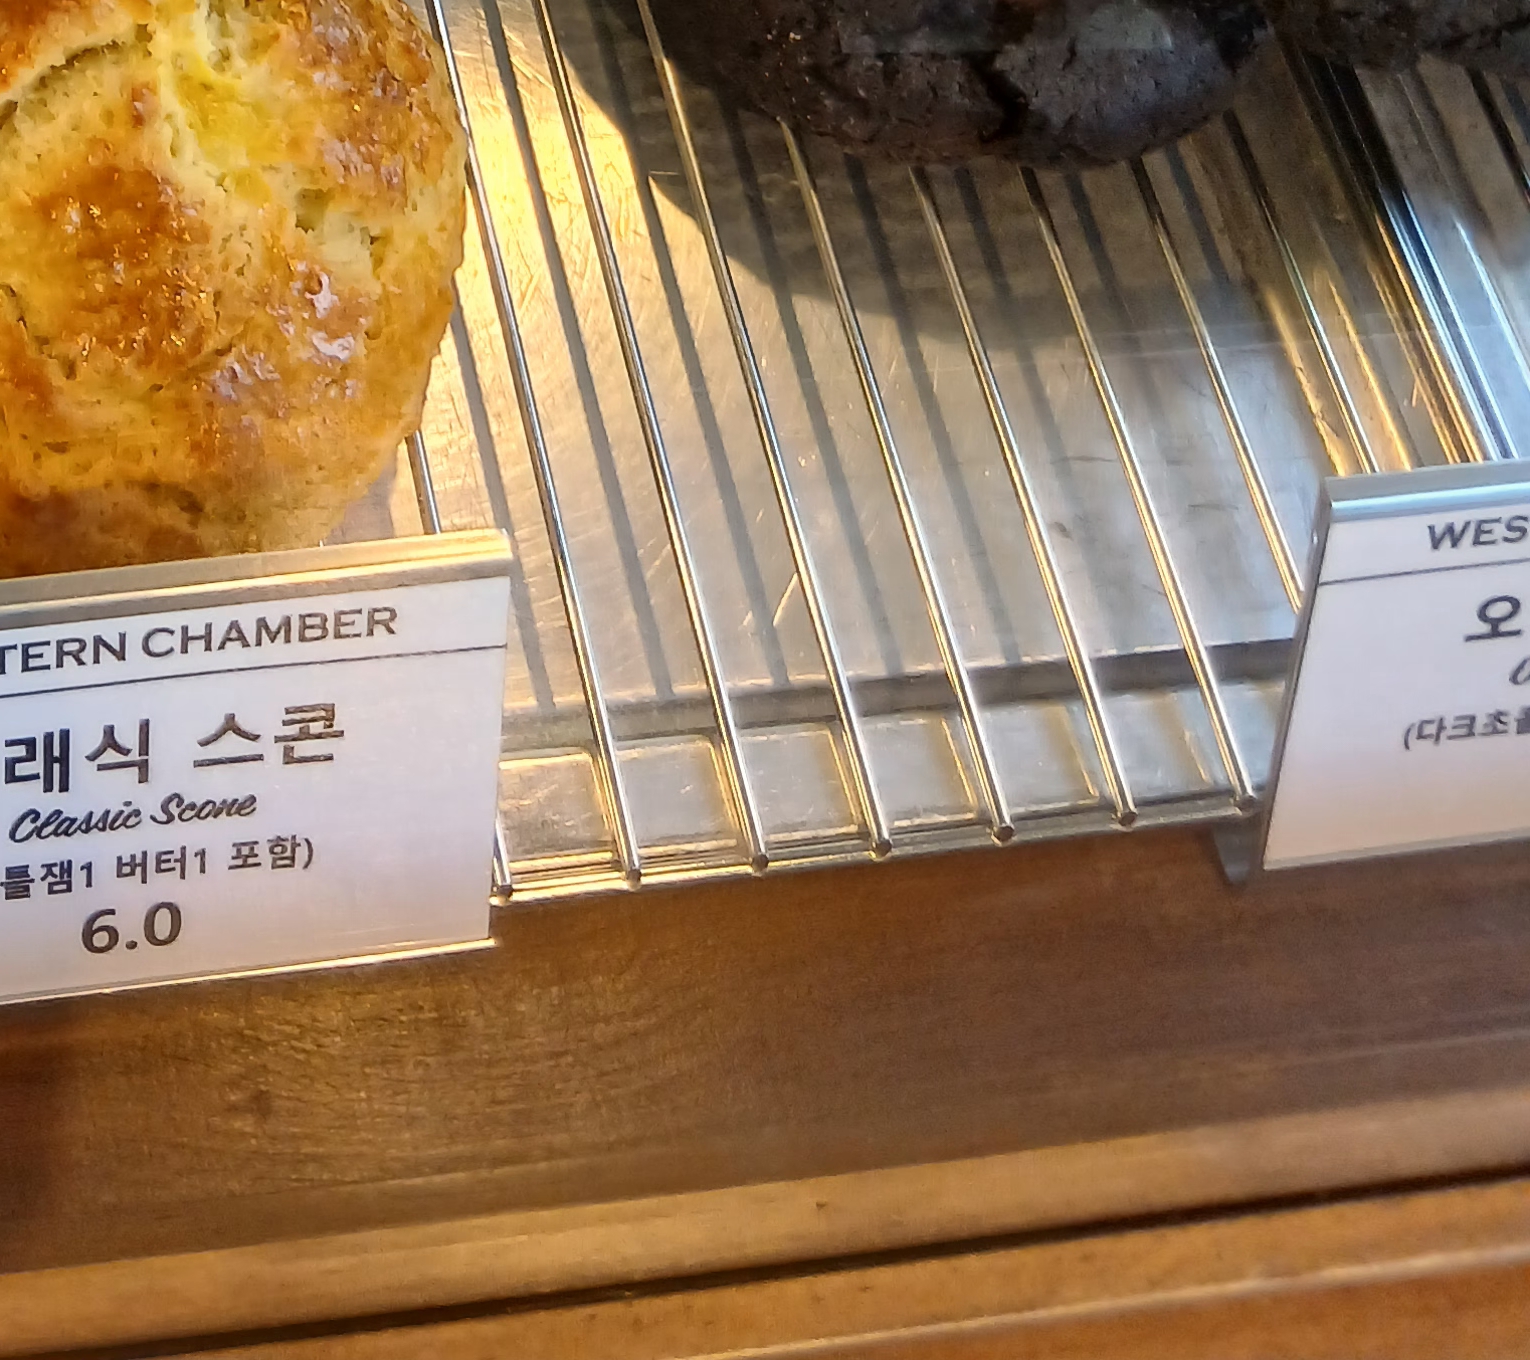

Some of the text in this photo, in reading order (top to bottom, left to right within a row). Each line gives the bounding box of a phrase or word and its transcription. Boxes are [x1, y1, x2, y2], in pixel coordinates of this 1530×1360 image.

[1426, 514, 1530, 551] WES
[141, 606, 400, 659] CHAMBER
[192, 702, 346, 771] 스콘
[8, 792, 258, 844] Classic Scone
[115, 844, 208, 885] 버터1
[227, 833, 315, 874] 포함)
[80, 900, 183, 955] 6.0
